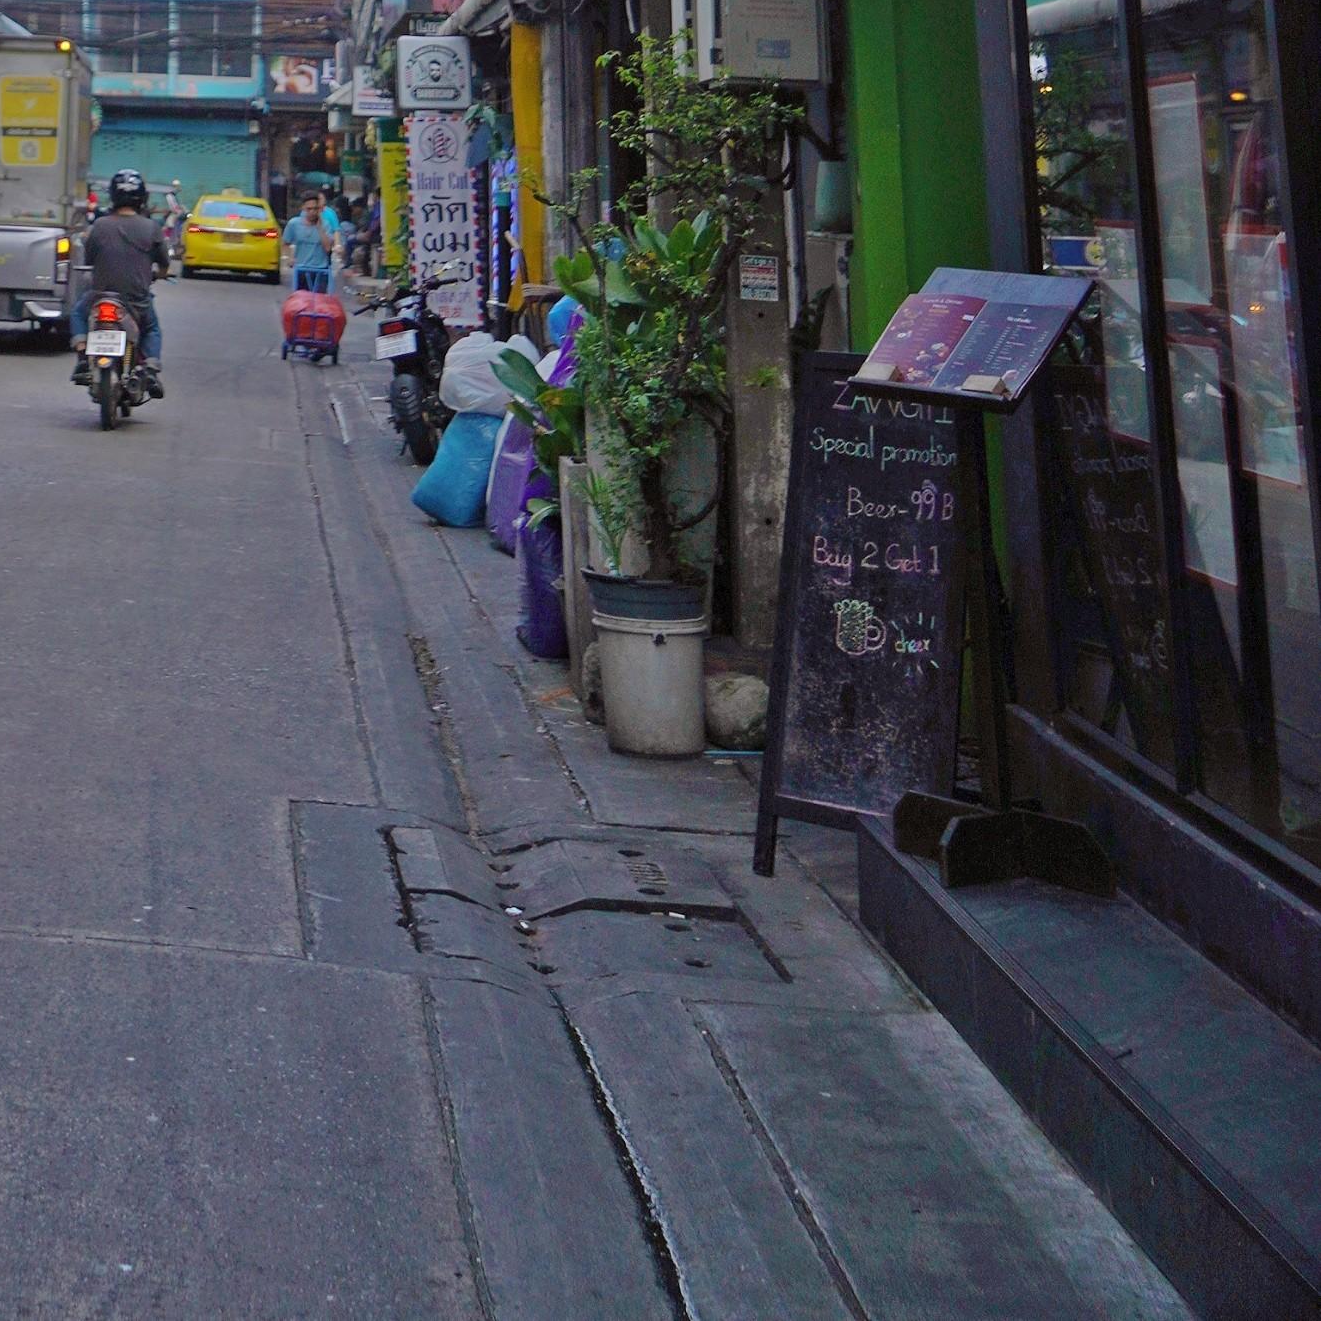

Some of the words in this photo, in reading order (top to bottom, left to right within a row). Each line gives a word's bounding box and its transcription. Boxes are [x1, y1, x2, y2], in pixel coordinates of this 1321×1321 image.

[416, 172, 444, 190] Hair
[449, 172, 470, 190] Cut
[421, 195, 467, 223] ตัด
[423, 232, 470, 253] ผม
[809, 425, 874, 463] Special
[881, 435, 958, 471] promotion
[814, 535, 852, 586] Buy
[861, 542, 879, 569] 2
[885, 543, 922, 573] Get
[929, 545, 941, 575] 1
